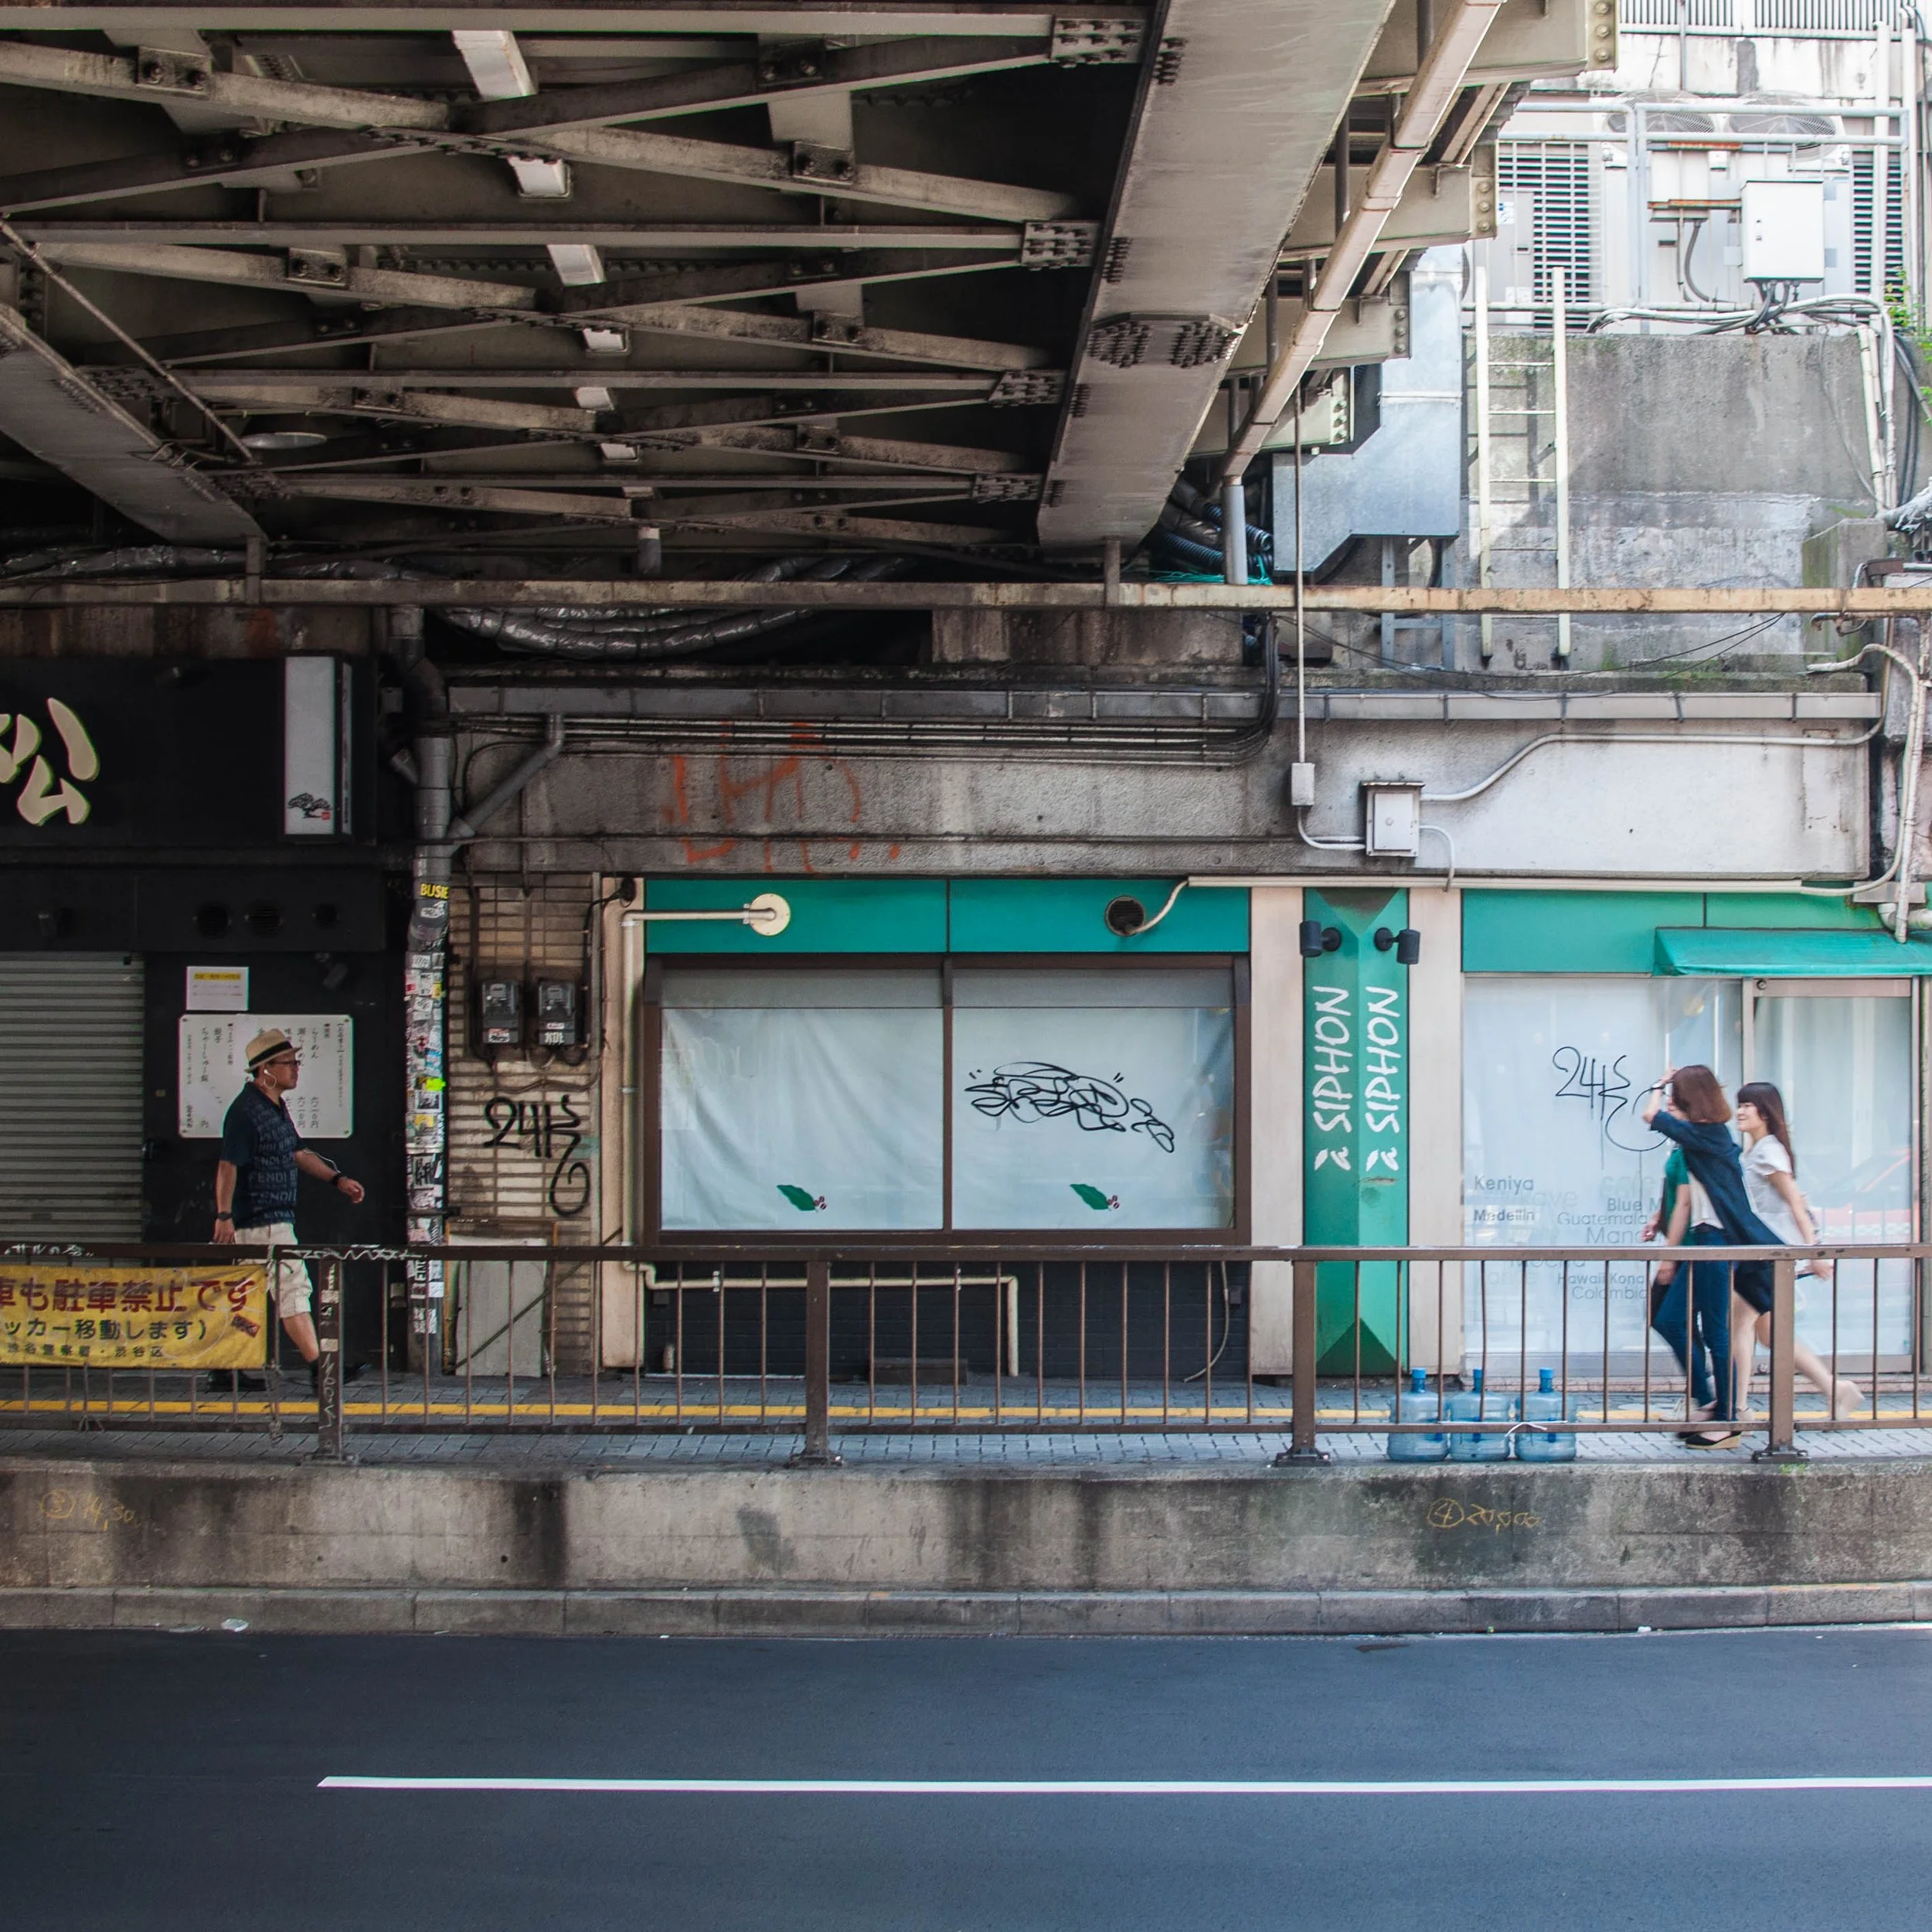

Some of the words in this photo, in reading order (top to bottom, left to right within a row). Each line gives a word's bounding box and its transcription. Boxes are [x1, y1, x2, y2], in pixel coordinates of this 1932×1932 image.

[1312, 986, 1352, 1133] SIPHON
[1364, 986, 1401, 1133] SIPHON
[1474, 1175, 1534, 1195] Keniya
[1607, 1198, 1642, 1212] Blue
[1558, 1212, 1648, 1226] Guatemala
[1610, 1273, 1645, 1284] Kona
[1572, 1286, 1647, 1300] Colombia
